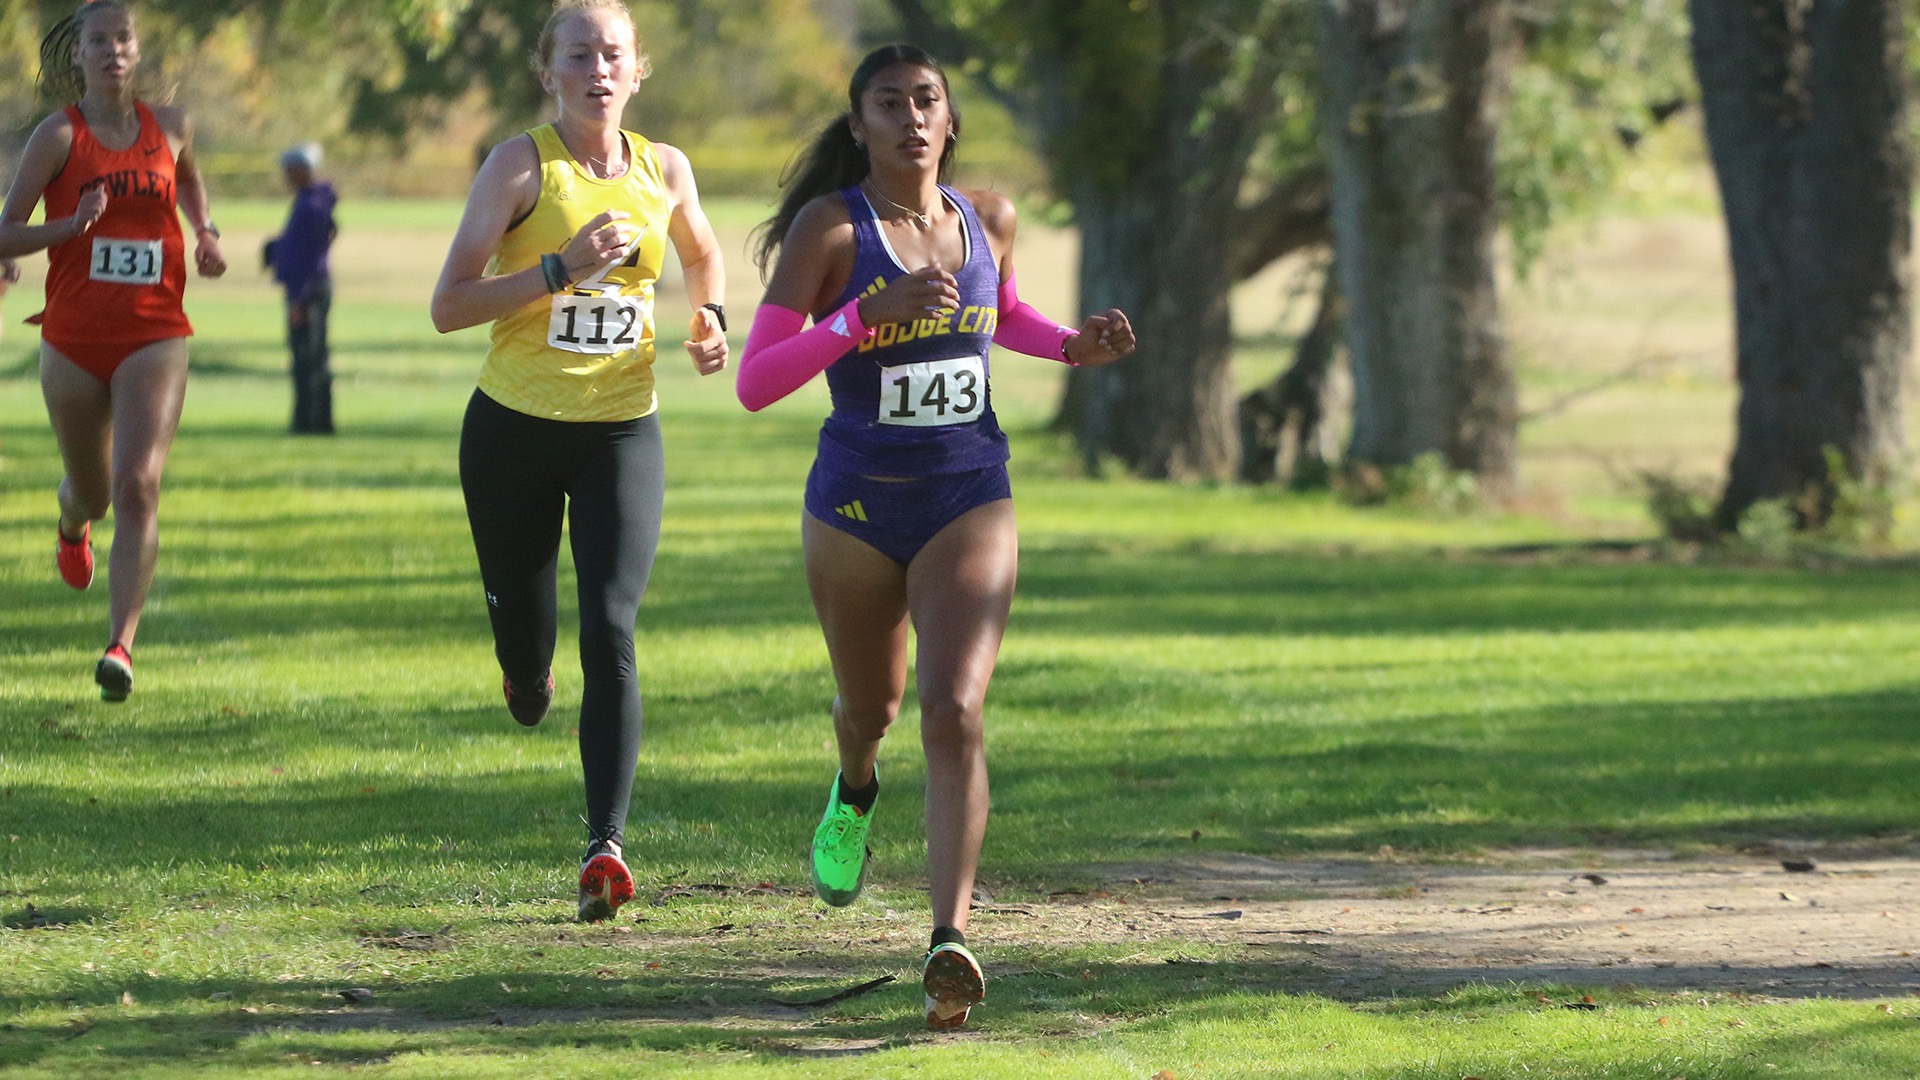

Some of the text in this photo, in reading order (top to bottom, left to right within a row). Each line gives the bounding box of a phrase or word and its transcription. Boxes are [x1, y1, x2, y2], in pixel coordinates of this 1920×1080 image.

[96, 245, 157, 277] 131
[556, 305, 636, 345] 112
[889, 369, 978, 418] 143
